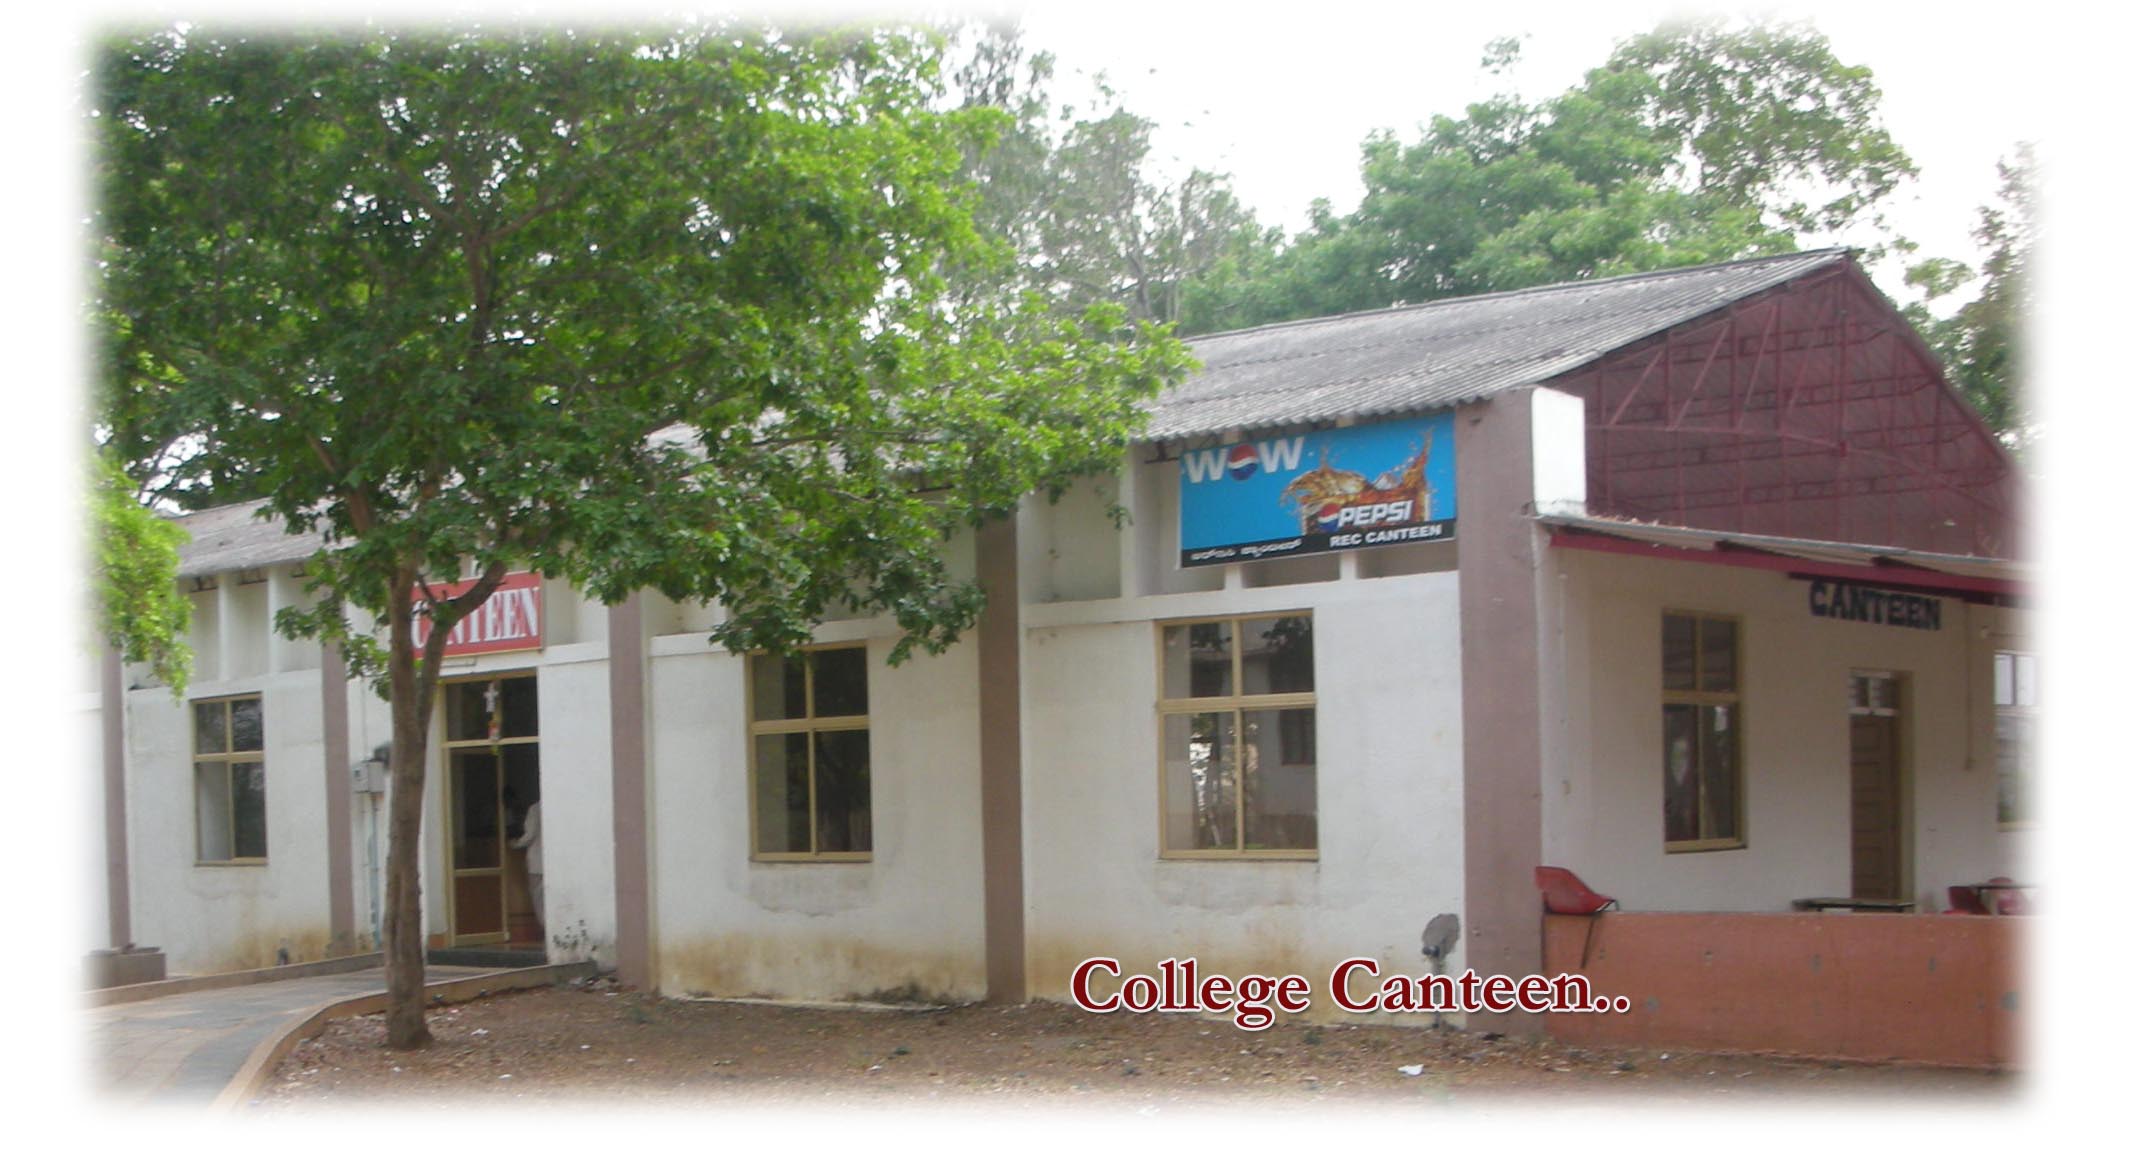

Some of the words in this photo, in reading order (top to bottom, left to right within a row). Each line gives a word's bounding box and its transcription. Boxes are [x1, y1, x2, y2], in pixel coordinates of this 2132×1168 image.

[1337, 500, 1413, 528] PEPSI
[1330, 533, 1362, 547] REC
[1365, 524, 1442, 543] CANTEEN
[1809, 578, 1942, 630] CANTEEN
